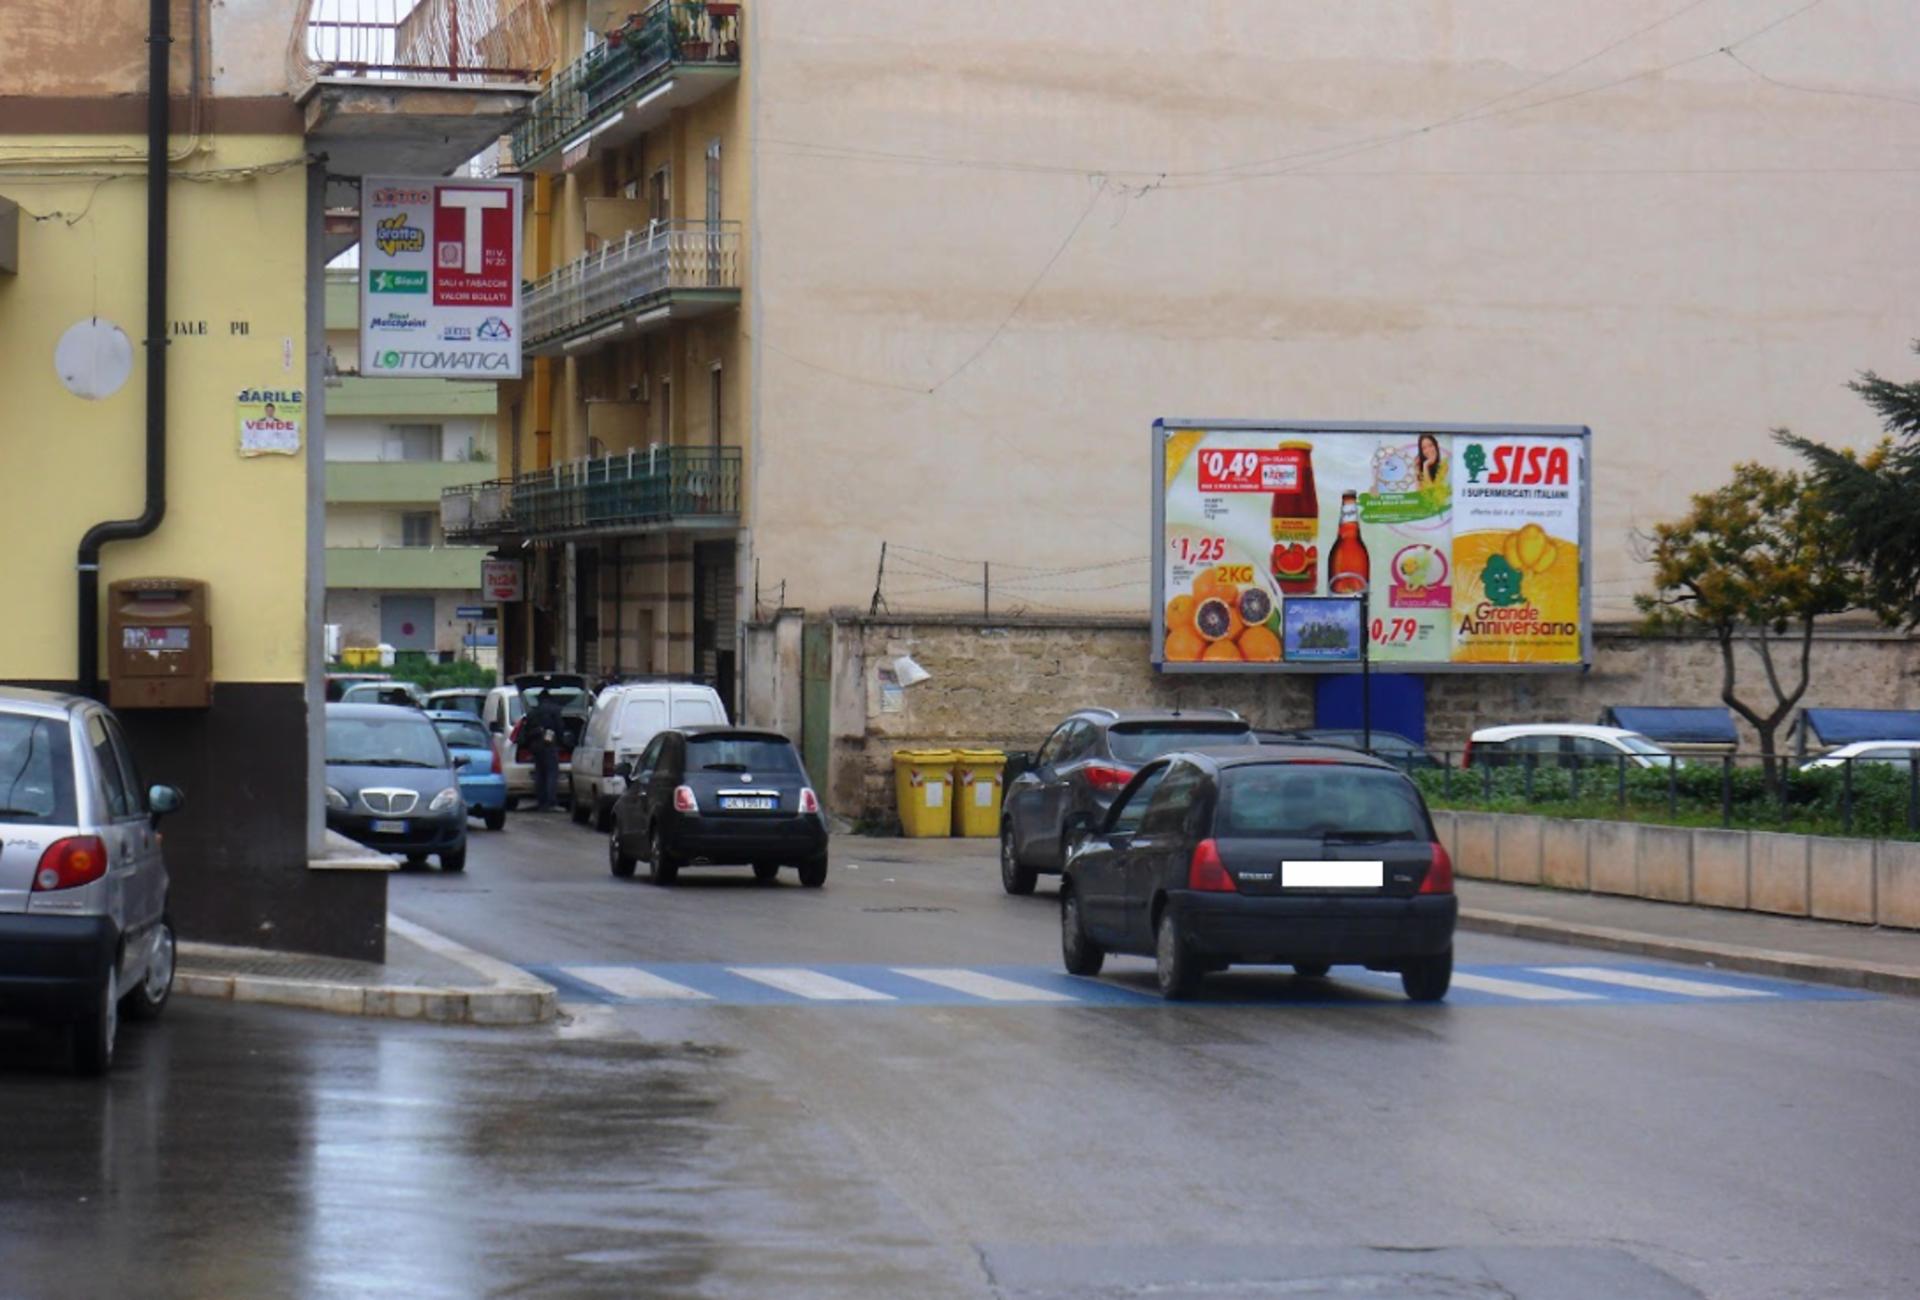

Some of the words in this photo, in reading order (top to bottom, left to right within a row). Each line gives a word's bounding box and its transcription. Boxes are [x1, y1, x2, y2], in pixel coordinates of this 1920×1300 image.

[373, 189, 431, 204] LOTTO
[394, 276, 425, 287] Sisal
[439, 279, 457, 288] SALI
[465, 280, 508, 288] TABACCHI
[372, 350, 510, 370] LOTTOMATICA
[238, 390, 302, 403] BARILE
[246, 421, 295, 431] VENDE
[1487, 445, 1570, 486] SISA
[1467, 488, 1532, 499] SUPERMERCATI
[1533, 490, 1569, 500] ITALIANI
[1475, 601, 1540, 622] Grande
[1459, 614, 1576, 636] Anniversario
